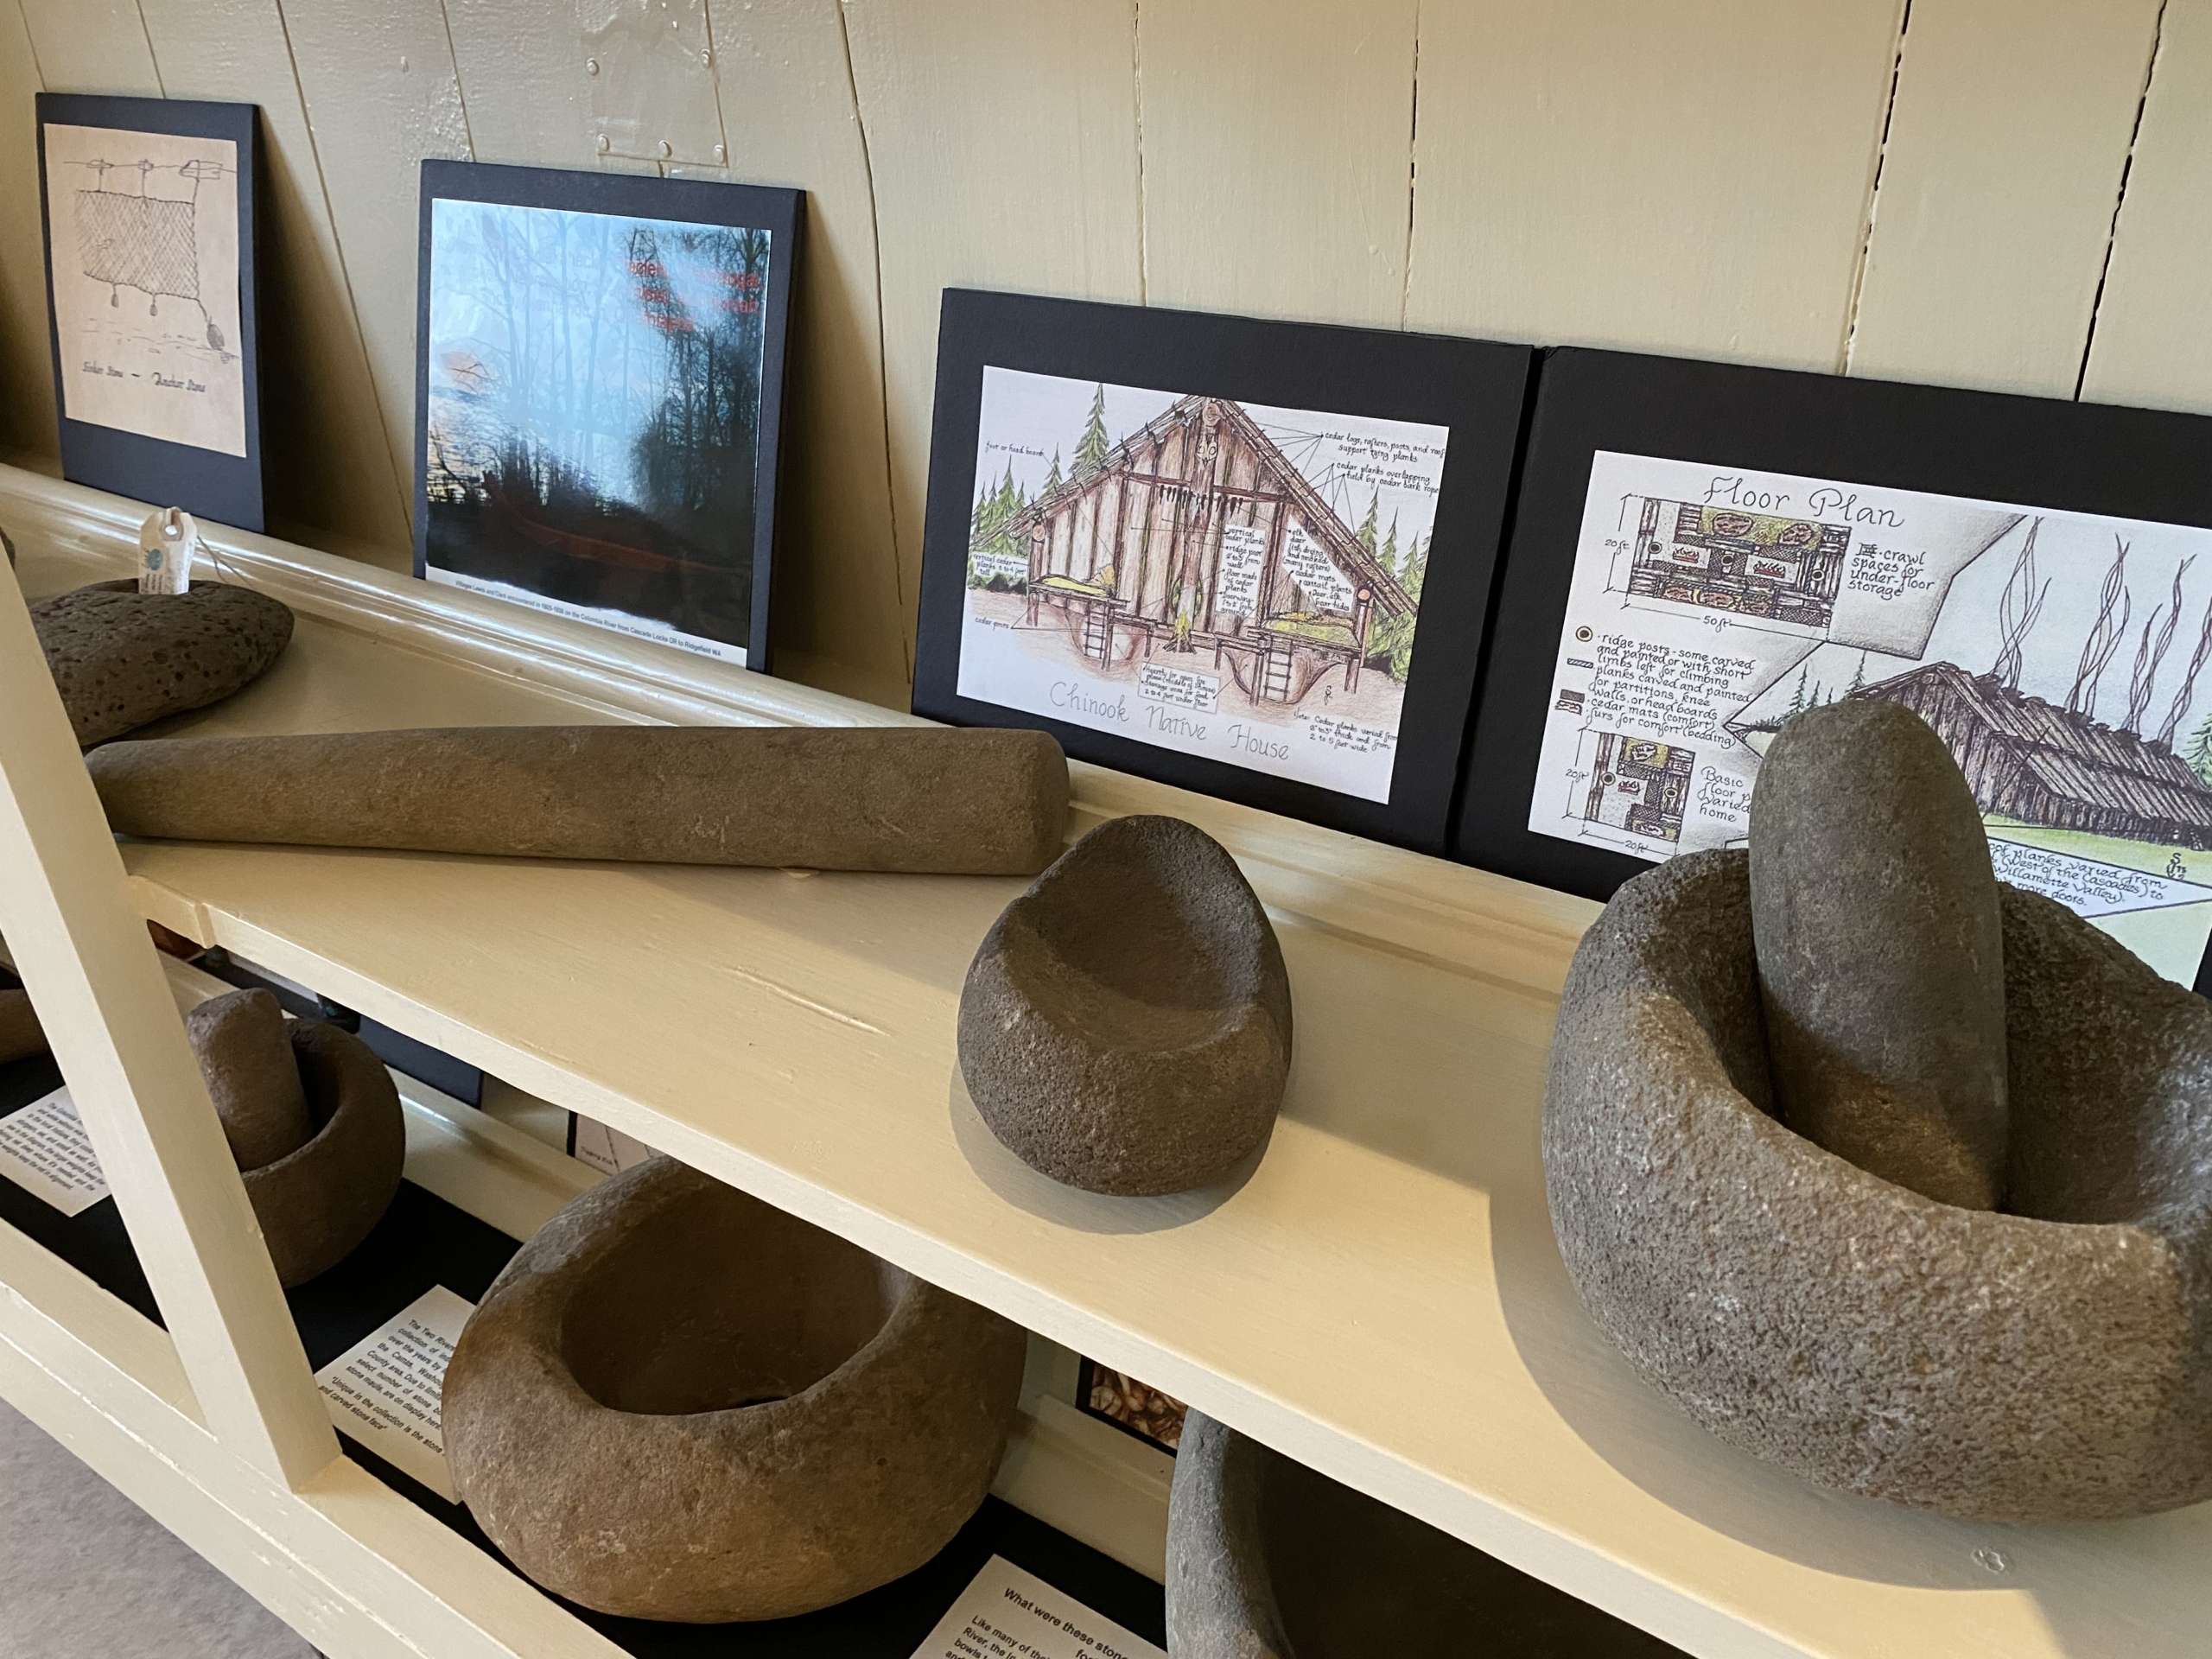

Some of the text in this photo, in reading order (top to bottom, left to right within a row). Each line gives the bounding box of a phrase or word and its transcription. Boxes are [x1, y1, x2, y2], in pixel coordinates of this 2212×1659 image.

[1008, 443, 1025, 453] head
[1325, 431, 1344, 441] cedar
[1413, 445, 1429, 454] and
[1431, 448, 1446, 458] roof
[1338, 444, 1367, 456] support
[1392, 451, 1418, 462] planks
[1337, 461, 1430, 486] cedar planks overlapping
[1346, 471, 1439, 498] held by cedar bark rope
[1703, 477, 1905, 528] Floor Plan
[1852, 557, 1923, 578] spaces for
[1884, 550, 1926, 565] crawl
[1847, 580, 1901, 601] storage
[473, 584, 486, 593] Lewis
[495, 590, 506, 599] Clark
[507, 594, 535, 607] encountered
[581, 613, 603, 625] Columbia
[604, 620, 617, 629] River
[617, 623, 630, 632] from
[630, 626, 652, 638] Cascade
[652, 633, 668, 642] Locks
[684, 641, 711, 654] Ridgefield
[1597, 645, 1619, 656] and
[1624, 650, 1666, 664] painted
[1682, 661, 1711, 673] with
[1713, 666, 1751, 680] short
[1602, 634, 1756, 670] ridge posts some carved
[1596, 664, 1752, 702] planks carved and painted
[1598, 653, 1729, 689] limbs left for climbing
[1588, 676, 1609, 691] for
[1682, 692, 1711, 707] knee
[1050, 681, 1129, 721] Chinook
[1227, 723, 1289, 760] House
[1586, 707, 1613, 725] furs
[1616, 713, 1635, 728] for
[1638, 718, 1683, 737] comfort
[1592, 698, 1715, 730] cedar mats (comfort)
[1676, 703, 1718, 720] boards
[1697, 782, 1736, 801] floor
[1700, 766, 1743, 787] Basic
[1700, 803, 1737, 822] home
[1993, 865, 2069, 888] Willamette
[2018, 883, 2046, 895] more
[2042, 866, 2056, 880] of
[2056, 868, 2078, 880] the
[2151, 890, 2163, 899] to
[2069, 861, 2121, 880] varied
[2121, 873, 2168, 889] from
[377, 1342, 389, 1351] the
[398, 1328, 428, 1348] collection
[409, 1319, 454, 1351] The Two Rivers
[367, 1350, 390, 1368] County
[404, 1374, 418, 1384] Due
[388, 1336, 404, 1345] over
[403, 1344, 414, 1353] the
[412, 1351, 432, 1364] years
[432, 1362, 442, 1370] by
[346, 1366, 365, 1379] stone
[383, 1390, 394, 1399] are
[403, 1402, 427, 1421] display
[356, 1358, 377, 1372] select
[377, 1372, 402, 1388] number
[412, 1395, 431, 1408] stone
[318, 1385, 334, 1395] and
[330, 1393, 354, 1408] carved
[351, 1407, 370, 1421] stone
[361, 1398, 373, 1408] the
[373, 1407, 404, 1428] collection
[411, 1431, 423, 1440] the
[423, 1439, 442, 1452] stone
[1004, 1587, 1034, 1611] What
[1034, 1605, 1061, 1626] were
[1062, 1622, 1094, 1645] these
[954, 1637, 982, 1659] bowls
[963, 1626, 1006, 1656] River, the
[971, 1615, 1032, 1654] Like many of
